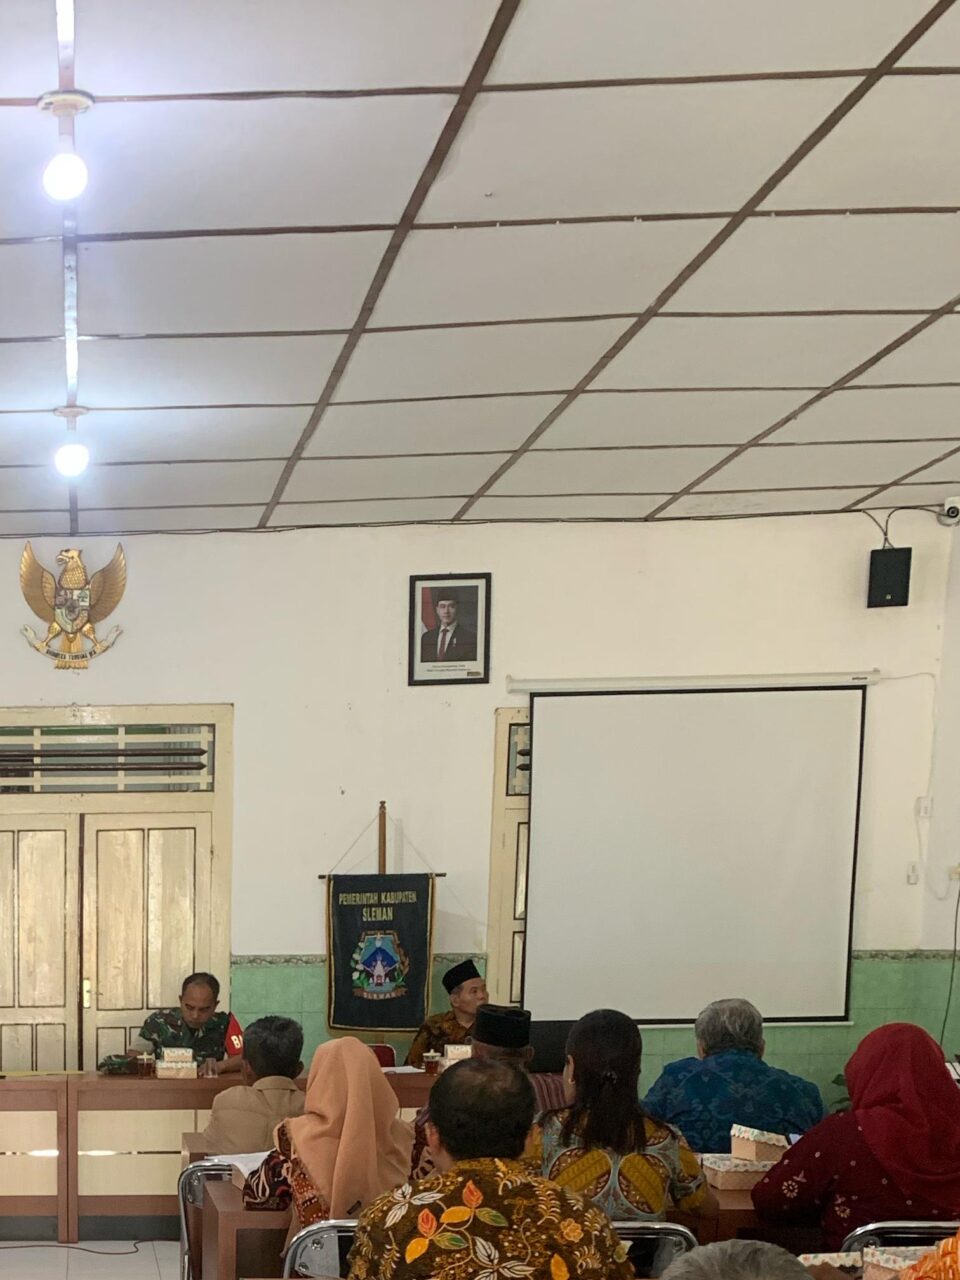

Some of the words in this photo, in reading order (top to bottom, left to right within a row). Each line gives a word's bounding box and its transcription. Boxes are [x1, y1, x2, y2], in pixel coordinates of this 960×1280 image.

[338, 892, 379, 905] PEMERINTAH
[380, 890, 417, 904] KABUPATEN
[362, 906, 393, 921] SLEMAN
